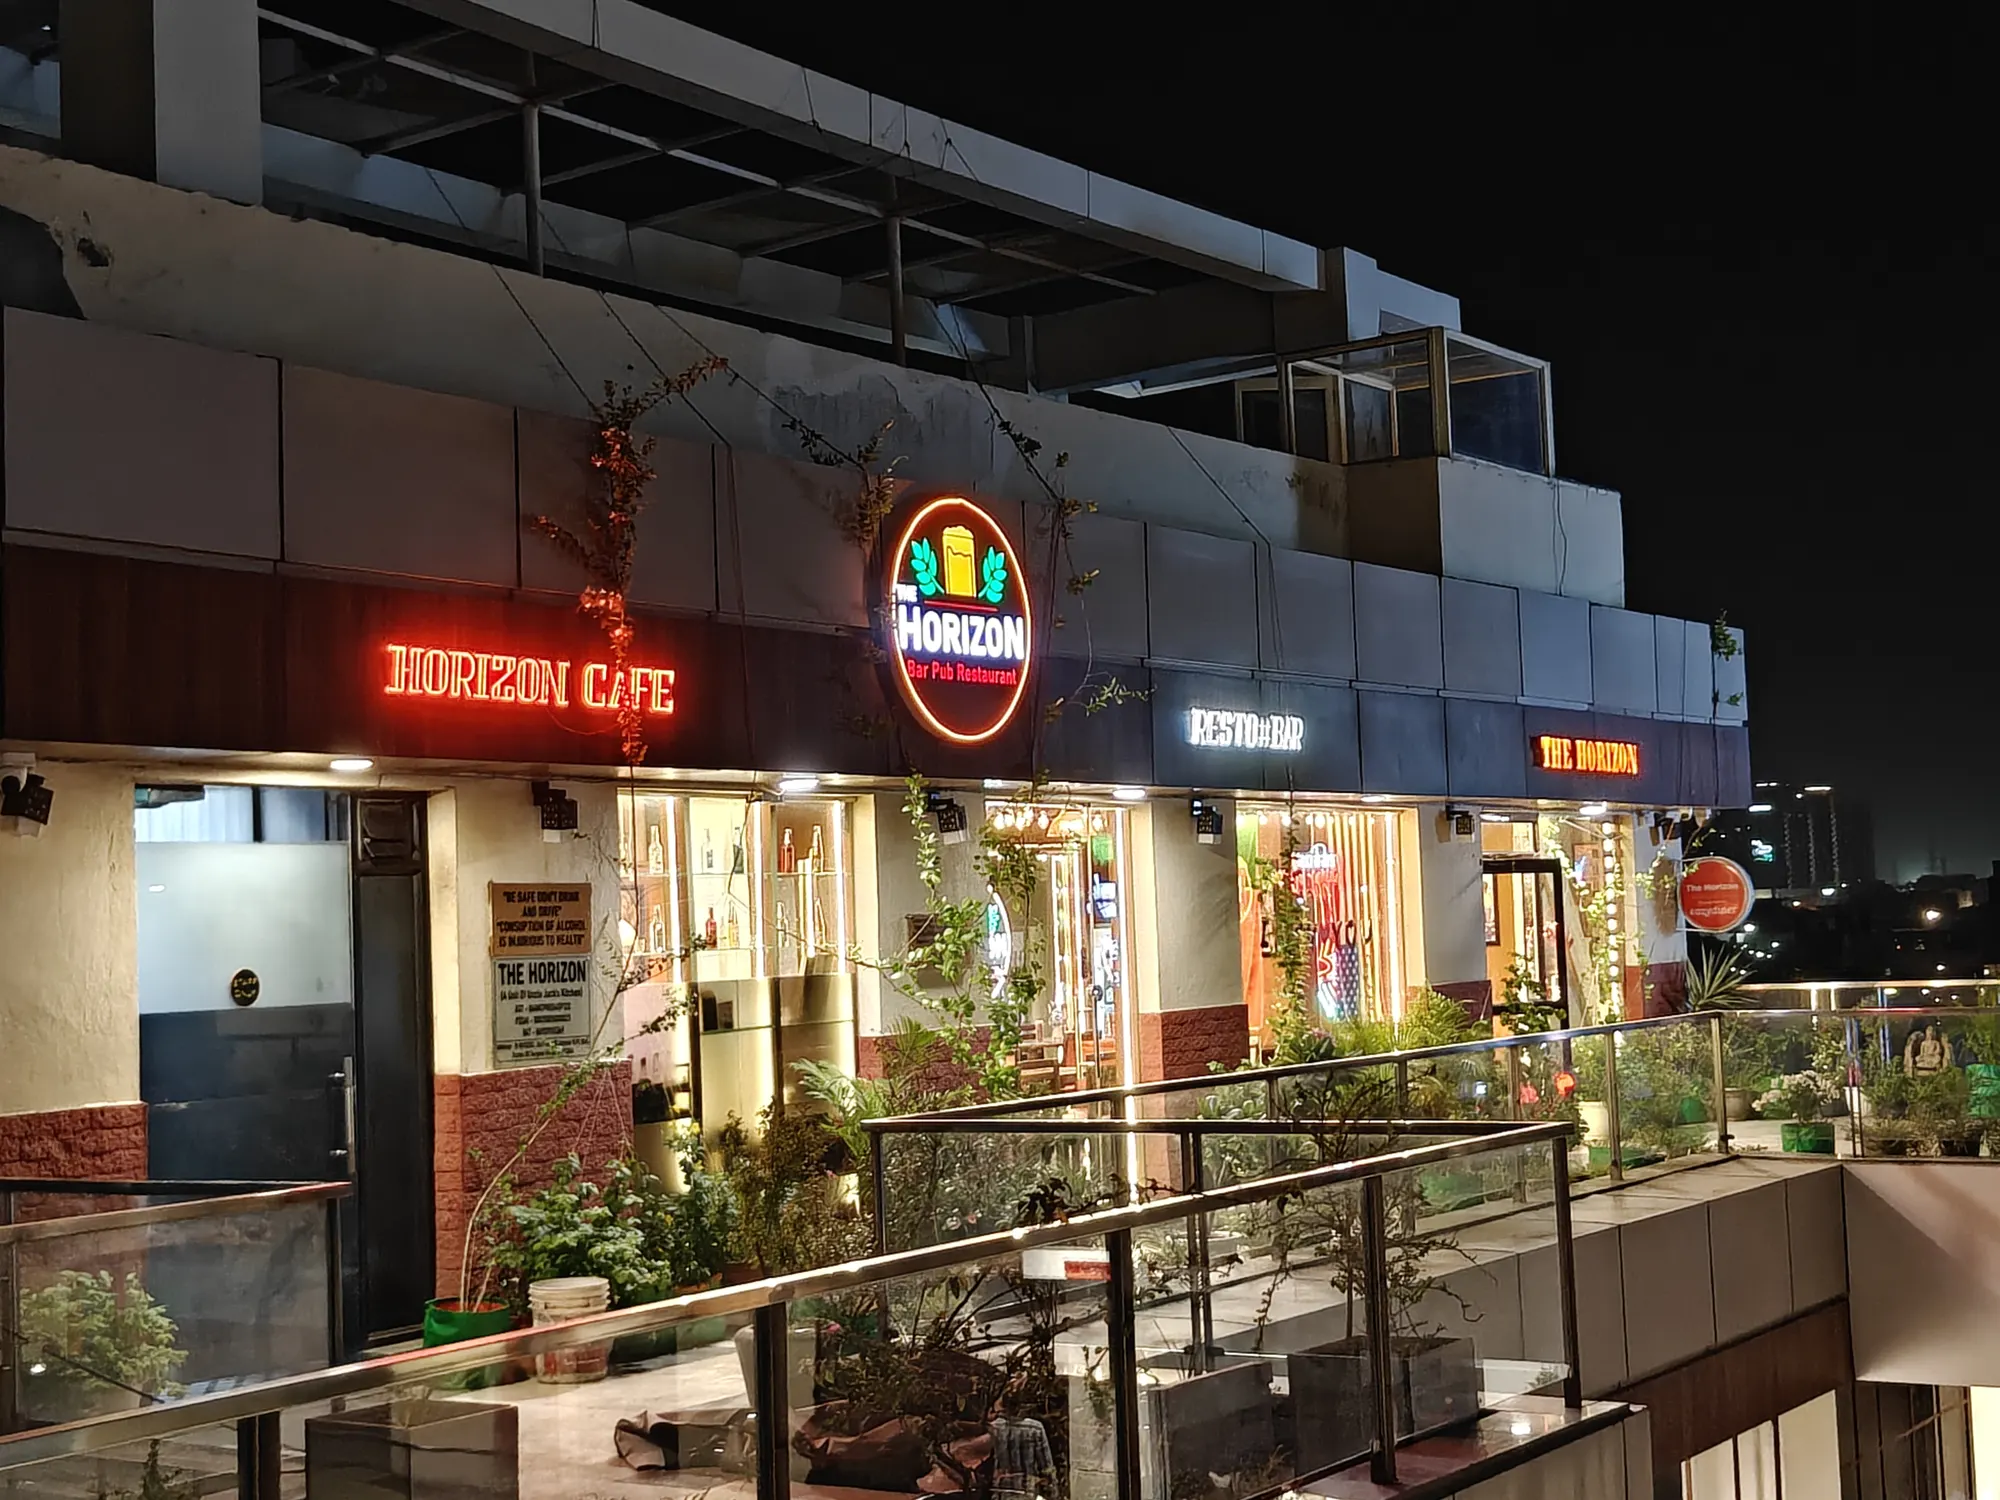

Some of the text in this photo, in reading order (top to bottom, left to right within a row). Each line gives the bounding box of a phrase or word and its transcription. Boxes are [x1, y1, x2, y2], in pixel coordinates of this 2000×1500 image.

[896, 584, 918, 602] THE
[898, 604, 1025, 659] HORIZON
[384, 643, 571, 707] HORIZON
[907, 660, 1017, 685] Bar Pub Restaurant
[1540, 736, 1638, 775] THE HORIZON
[517, 891, 536, 902] SAFE
[545, 935, 555, 945] TO
[498, 960, 586, 985] THE HORIZON
